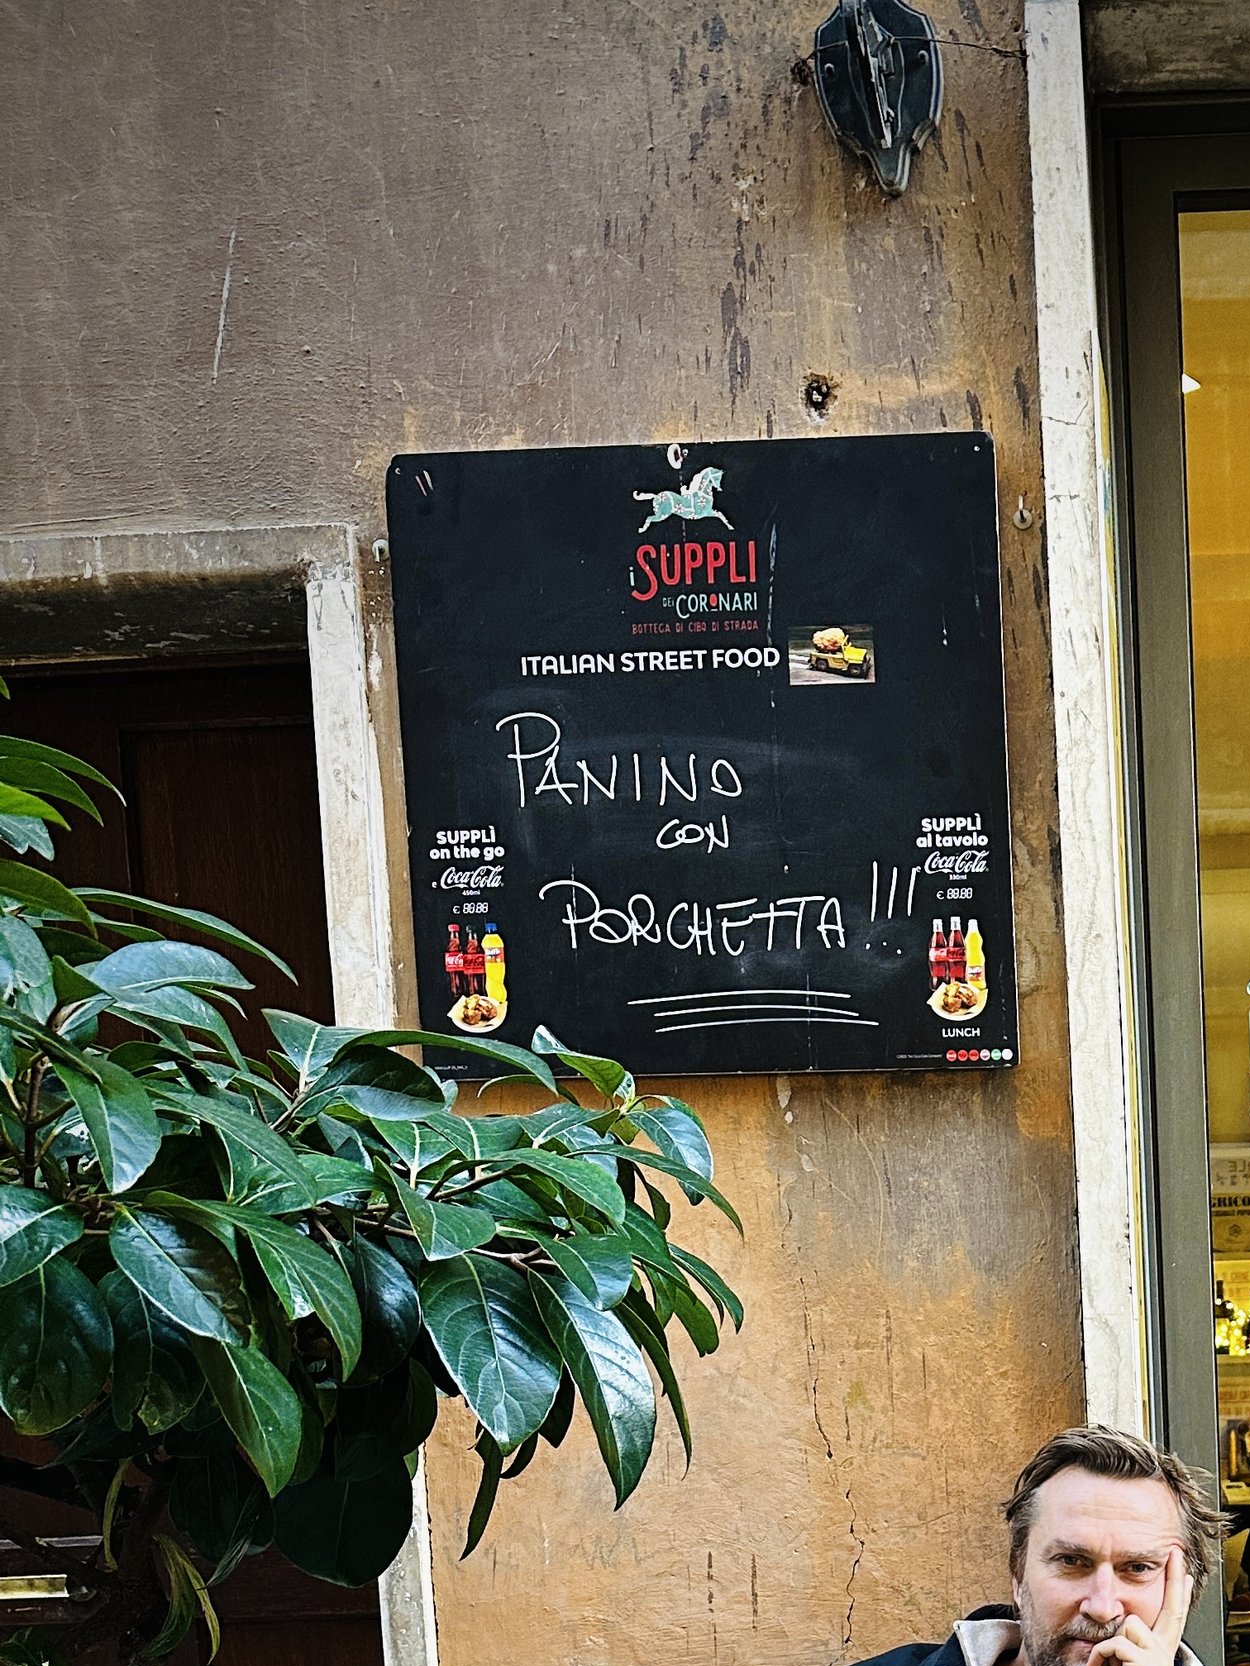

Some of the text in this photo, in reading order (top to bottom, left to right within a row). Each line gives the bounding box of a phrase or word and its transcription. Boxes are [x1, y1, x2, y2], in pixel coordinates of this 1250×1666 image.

[631, 540, 756, 601] SUPPLI
[676, 592, 758, 619] CORONARI
[632, 620, 759, 635] BOTTEGA DI CIBO DI STRADA
[521, 647, 780, 676] ITALIAN STREET FOOD
[495, 711, 742, 808] PANINO
[921, 813, 981, 832] SUPPLÌ
[436, 825, 496, 844] SUPPLÌ
[656, 814, 729, 853] CON
[916, 831, 988, 848] al tavolo
[429, 844, 505, 861] on the go
[942, 1028, 980, 1038] LUNCH
